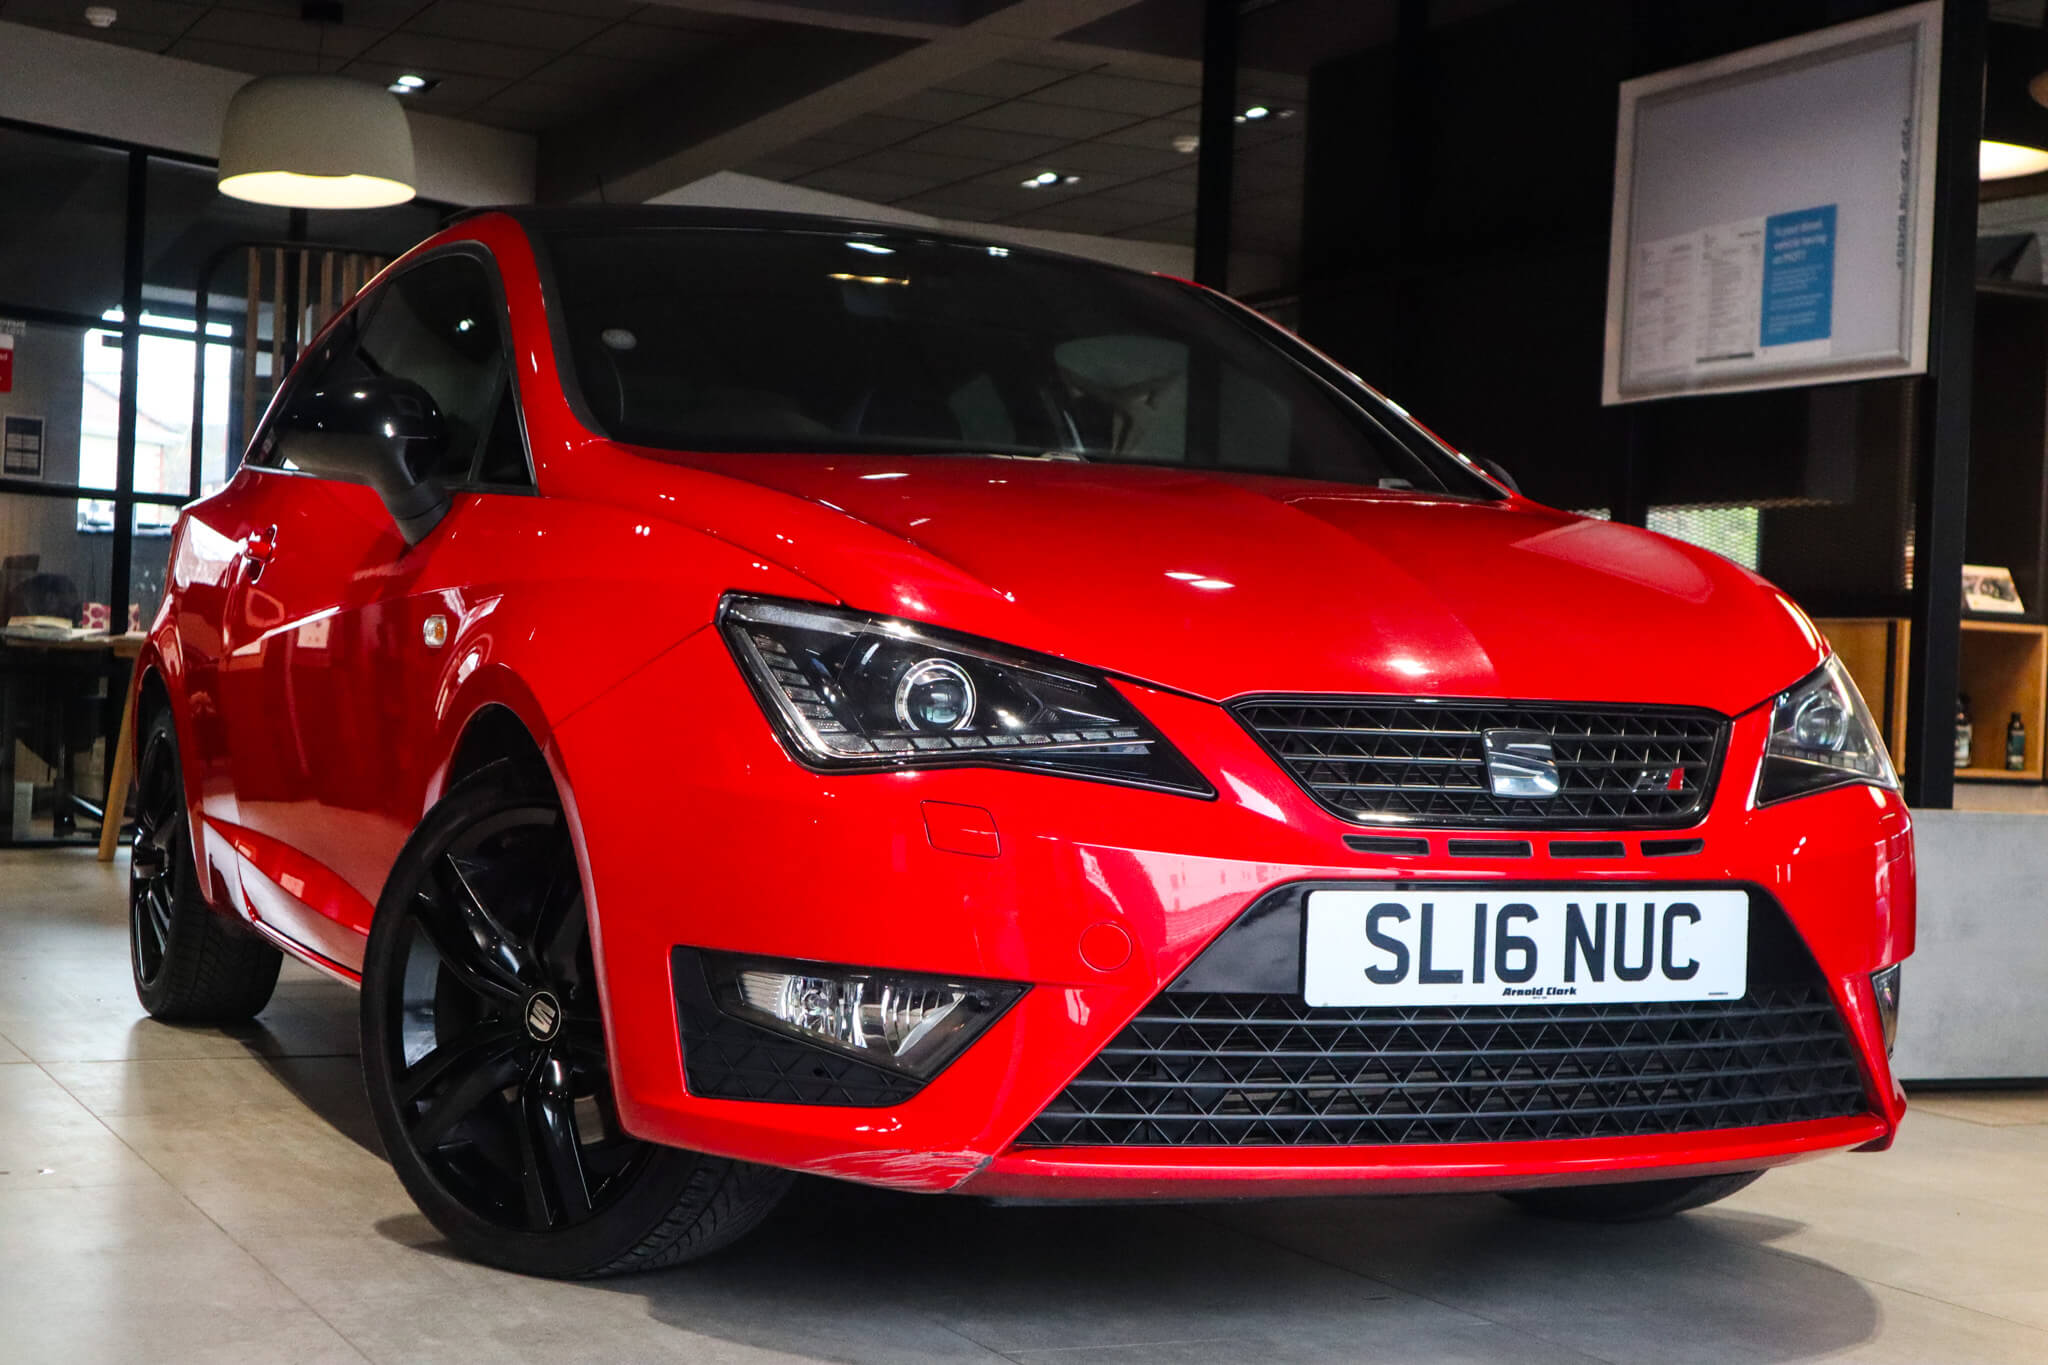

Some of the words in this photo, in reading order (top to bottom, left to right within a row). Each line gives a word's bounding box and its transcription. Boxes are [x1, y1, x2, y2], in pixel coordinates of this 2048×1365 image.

[1364, 903, 1539, 984] SL16
[1564, 902, 1701, 982] NUC
[1502, 987, 1544, 996] Arnold
[1546, 986, 1577, 995] Clark
